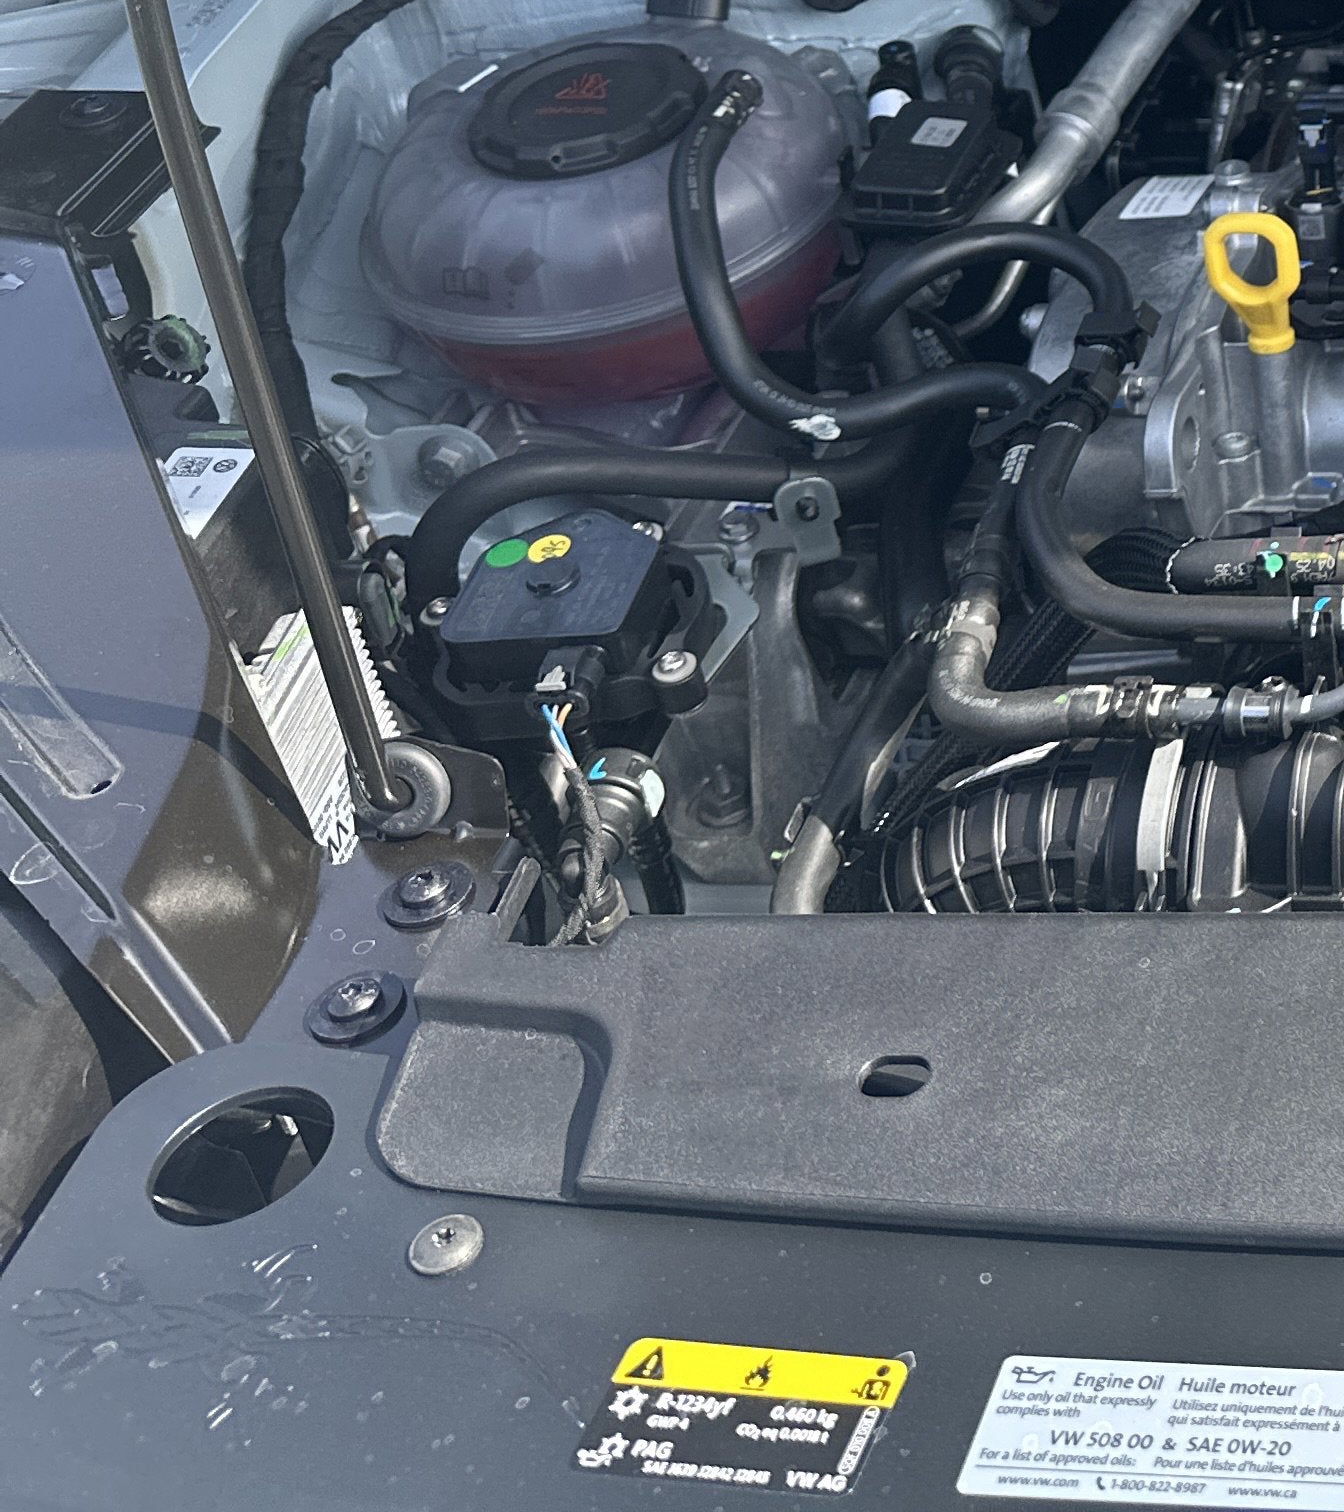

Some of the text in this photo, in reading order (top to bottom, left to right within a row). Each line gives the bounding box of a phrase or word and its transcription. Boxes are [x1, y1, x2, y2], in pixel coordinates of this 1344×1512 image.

[1073, 1372, 1165, 1392] Engine Oil
[1178, 1377, 1296, 1397] Huile moteur
[1001, 1390, 1157, 1410] Use only oil that expressly
[1172, 1399, 1218, 1412] Utilisez
[1220, 1401, 1297, 1417] uniquement
[1299, 1403, 1316, 1416] de
[655, 1392, 736, 1420] R-1234yf
[770, 1405, 815, 1424] 0.460
[816, 1410, 839, 1430] kg
[996, 1404, 1081, 1418] complies with
[1167, 1414, 1340, 1432] qui satisfait expressément à
[630, 1440, 674, 1460] PAG
[1050, 1430, 1292, 1456] VW 508 00 & SAE 0W-20
[979, 1448, 1136, 1467] For a list of approved oils:
[1153, 1456, 1184, 1469] Pour
[1184, 1459, 1208, 1470] une
[1211, 1459, 1235, 1472] liste
[1237, 1460, 1285, 1474] d'huiles
[786, 1470, 819, 1488] VW
[818, 1474, 848, 1492] AG
[997, 1475, 1297, 1498] www.vw.com 1-800-822-8987 www.vw.ca
